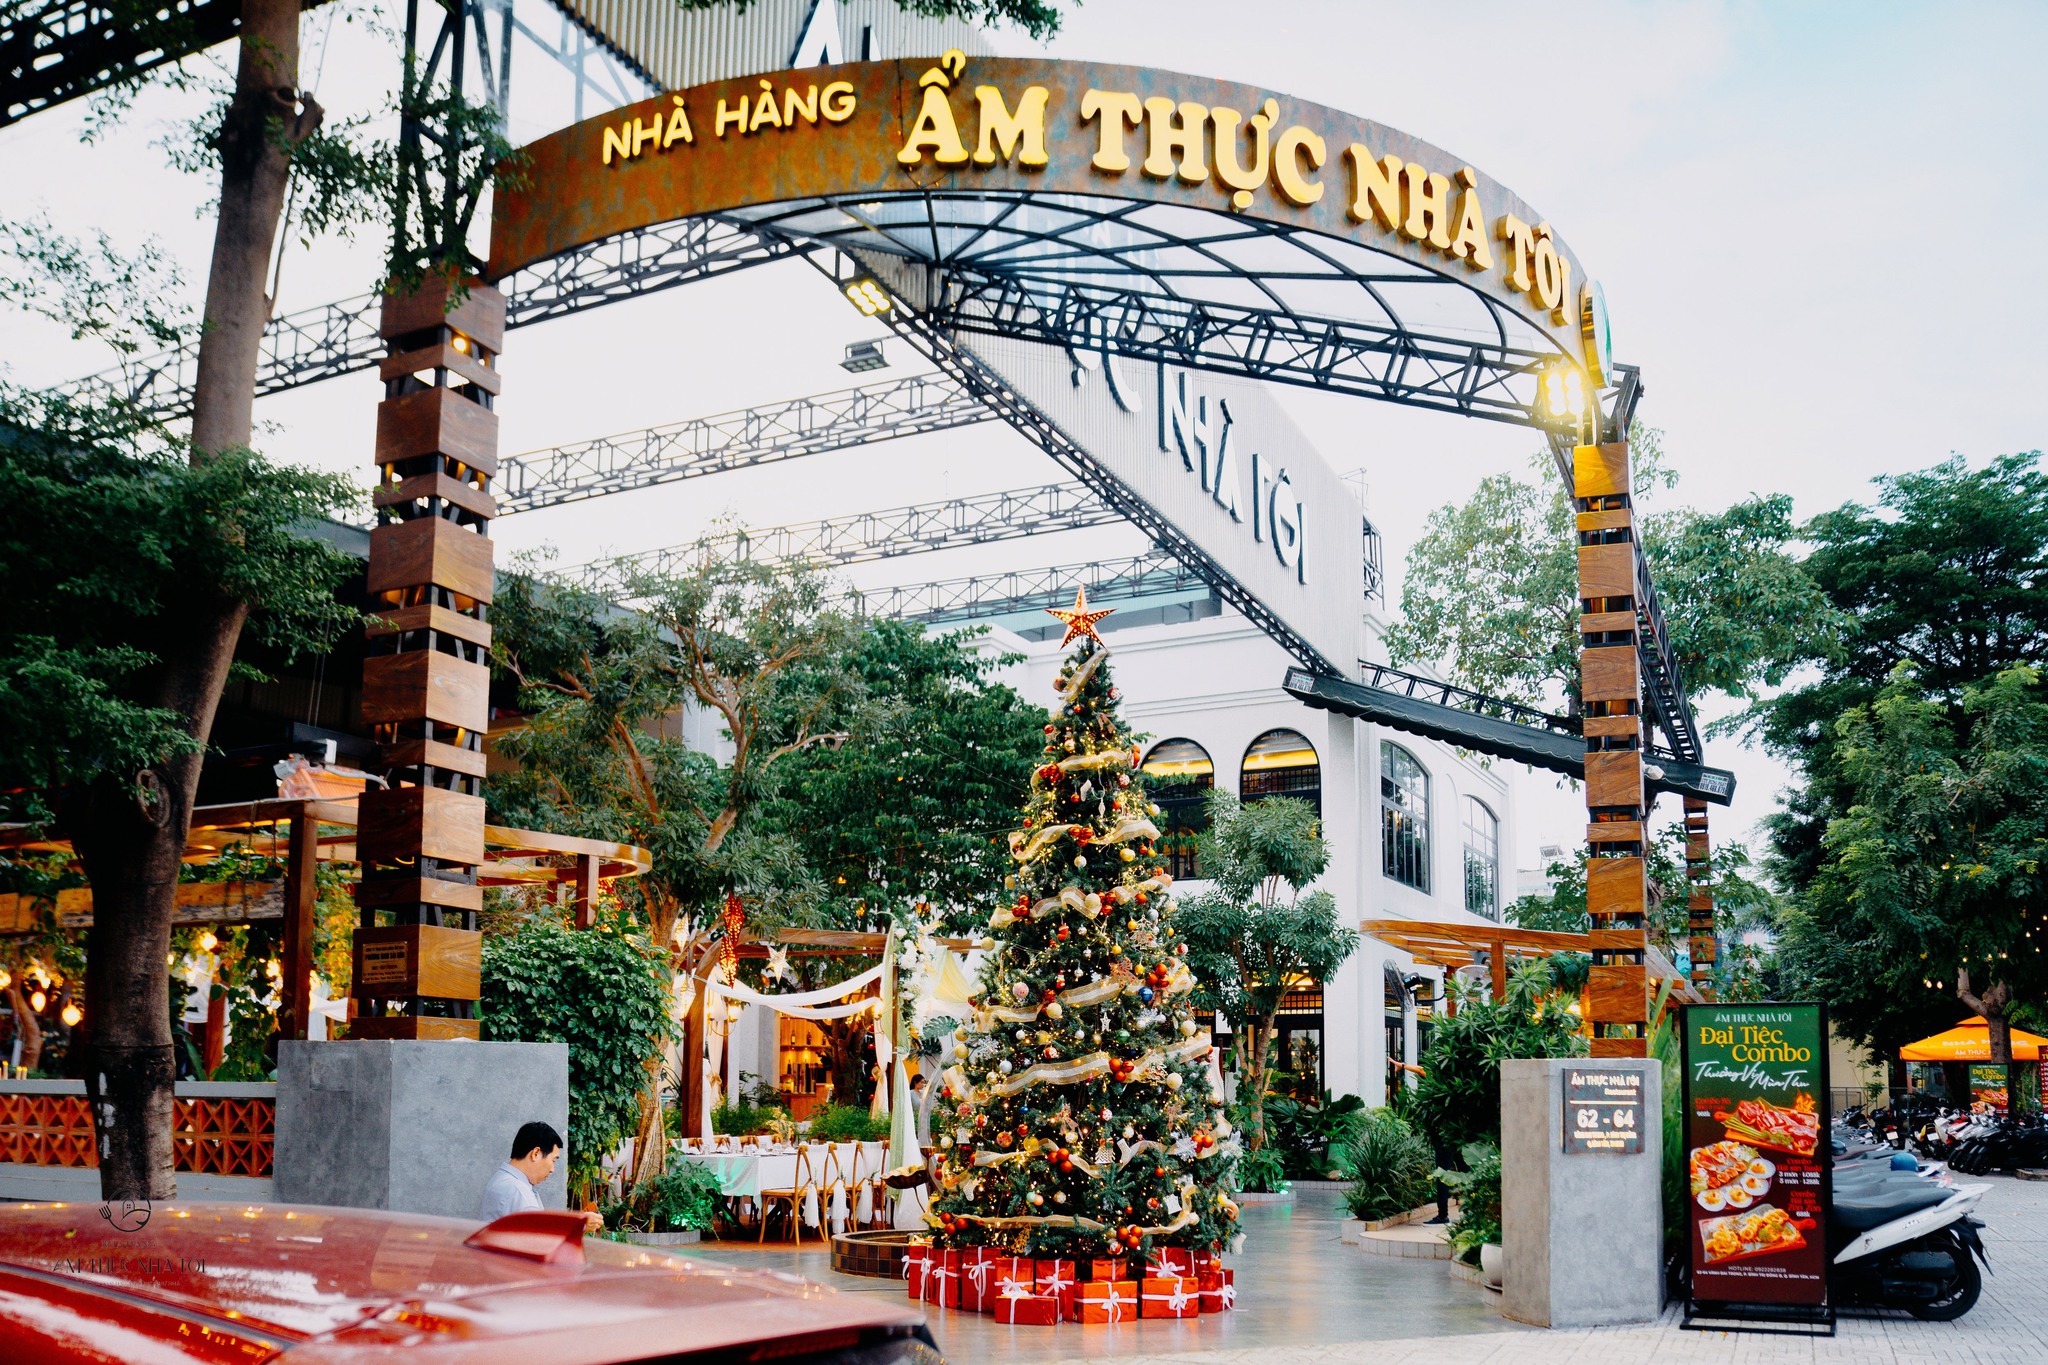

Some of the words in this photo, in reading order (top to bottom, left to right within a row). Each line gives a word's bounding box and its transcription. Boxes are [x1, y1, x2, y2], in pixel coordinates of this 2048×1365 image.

[602, 96, 694, 166] NHÀ
[714, 79, 858, 138] HÀNG
[896, 48, 1051, 172] ẨM
[1080, 88, 1328, 210] THỰC
[1344, 141, 1496, 273] NHÀ
[1497, 212, 1576, 328] TÔI
[1699, 1025, 1734, 1048] Đại
[1740, 1025, 1783, 1048] Tiệc
[1731, 1042, 1811, 1062] Combo
[1577, 1108, 1599, 1128] 62
[1613, 1109, 1635, 1128] 64
